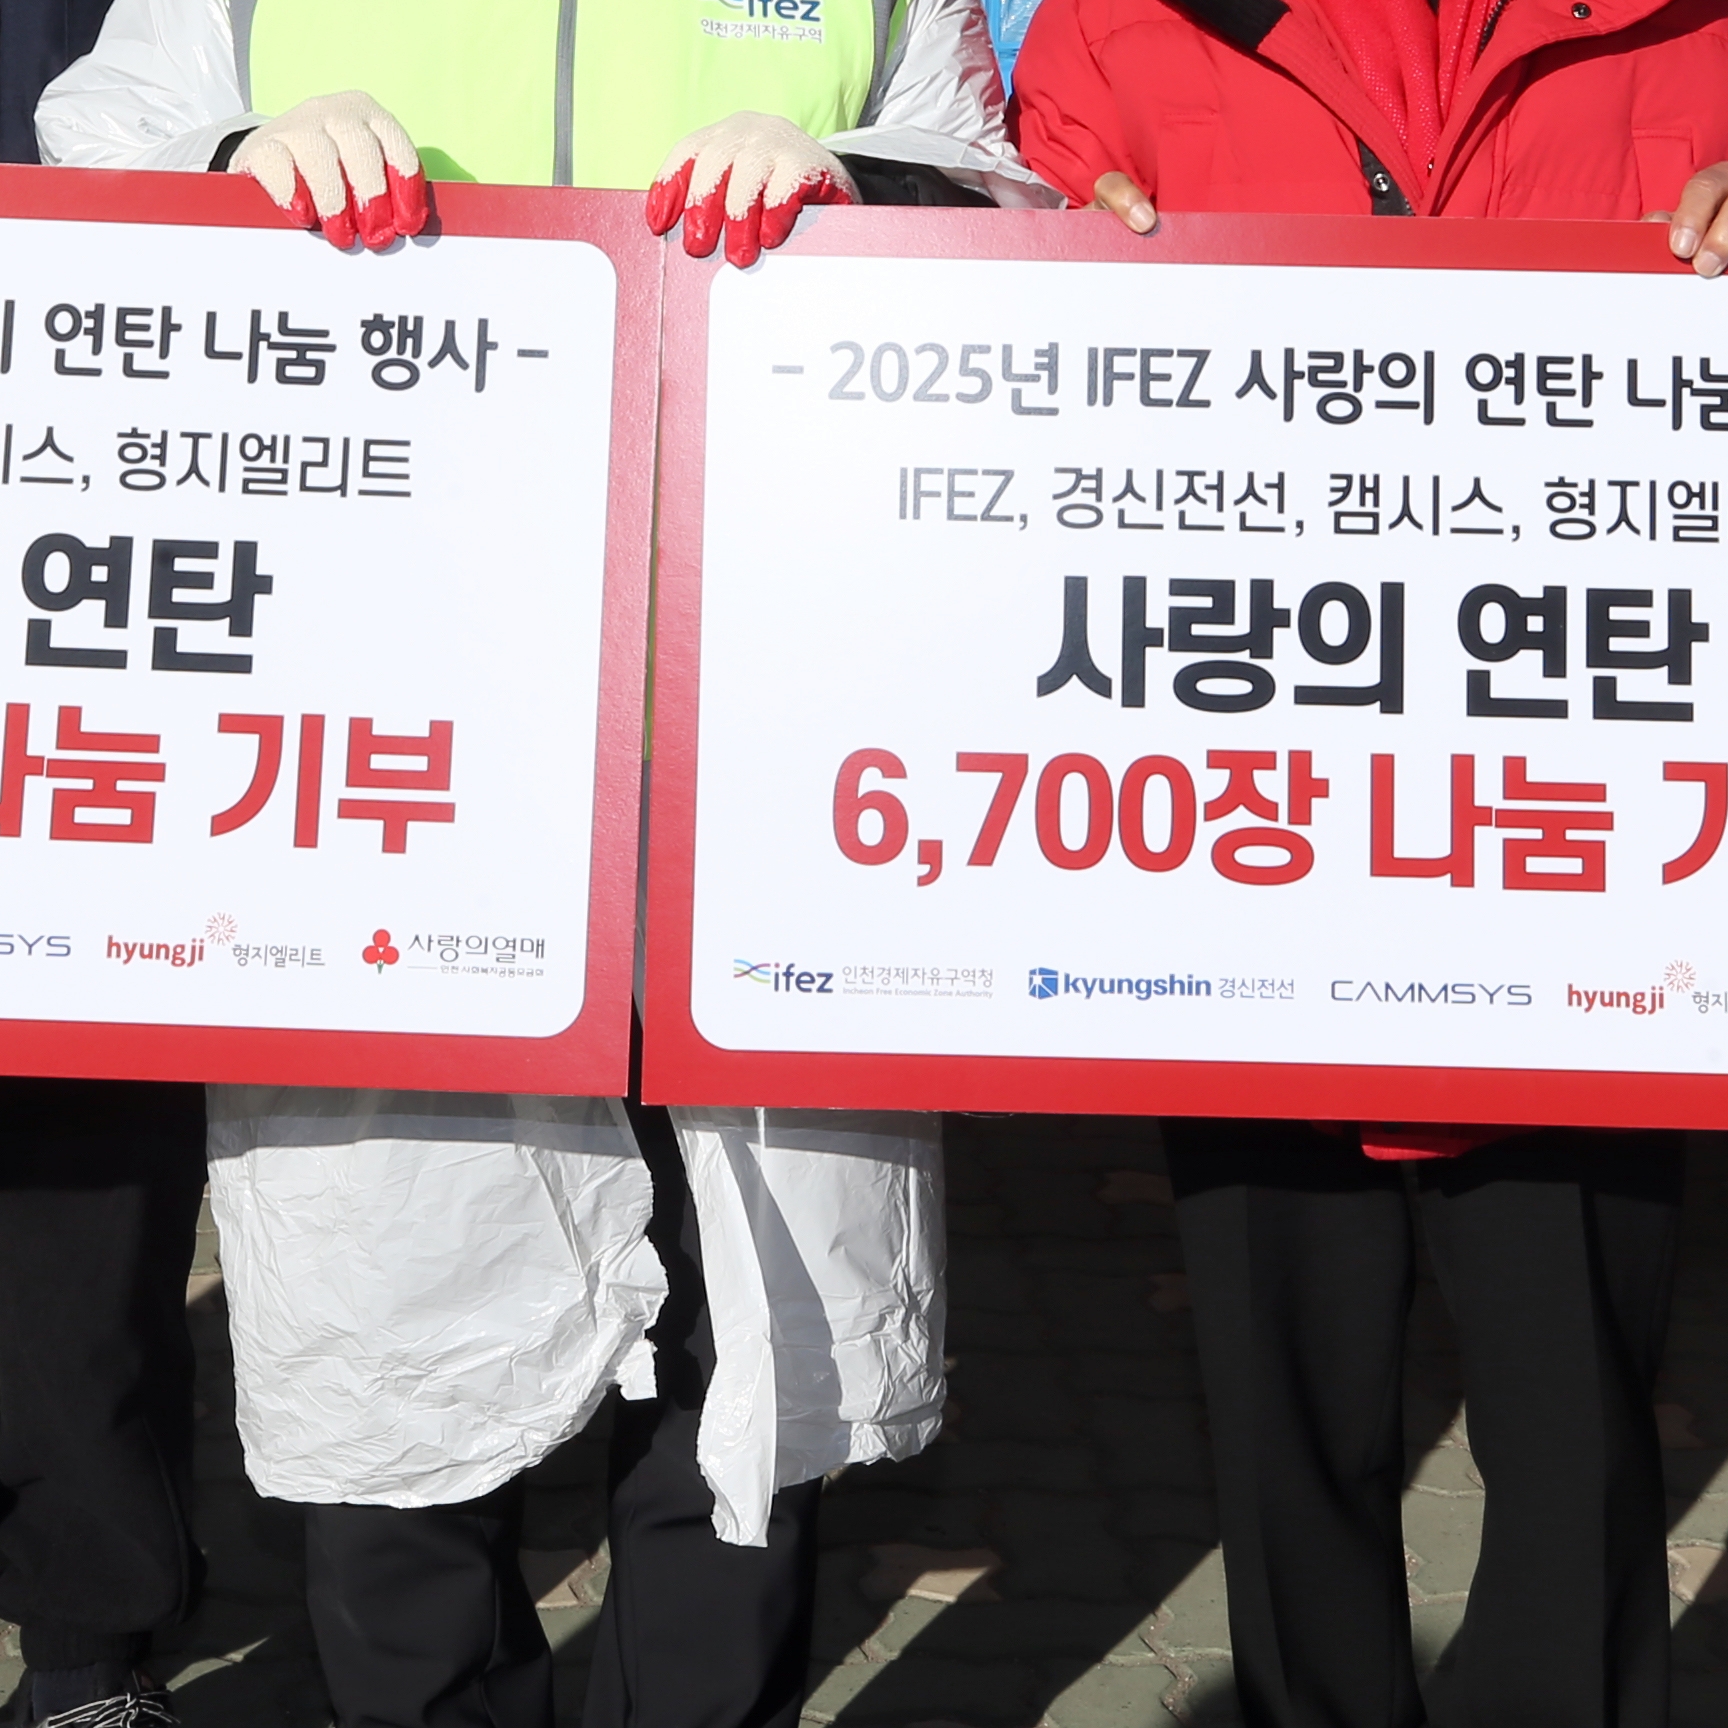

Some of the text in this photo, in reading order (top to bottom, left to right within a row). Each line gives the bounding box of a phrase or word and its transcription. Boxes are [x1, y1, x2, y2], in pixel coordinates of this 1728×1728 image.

[43, 303, 183, 380] 연탄
[203, 309, 338, 387] 나눔
[359, 313, 499, 393] 행사
[827, 341, 1060, 417] 2025년
[1086, 347, 1212, 409] IFEZ
[1234, 347, 1436, 427] 사랑의
[1464, 352, 1605, 429] 연탄
[116, 426, 412, 499] 형지엘리트
[896, 467, 1028, 532] IFEZ,
[1051, 466, 1305, 538] 경신전선,
[1327, 472, 1521, 543] 캠시스,
[21, 532, 274, 675] 연탄
[1035, 574, 1711, 723] 사랑의 연탄
[209, 712, 457, 855] 기부
[831, 747, 1331, 888] 6,700장
[1369, 752, 1615, 894] 나눔
[106, 934, 326, 969] hyungji 형지엘리트
[407, 934, 546, 963] 사랑의열매
[773, 962, 834, 994] ifez
[842, 965, 994, 988] 인천경제자유구역청
[1063, 972, 1295, 1002] kyungshin 경신전선
[1330, 979, 1533, 1006] CAMMSYS
[1567, 982, 1665, 1016] hyungji
